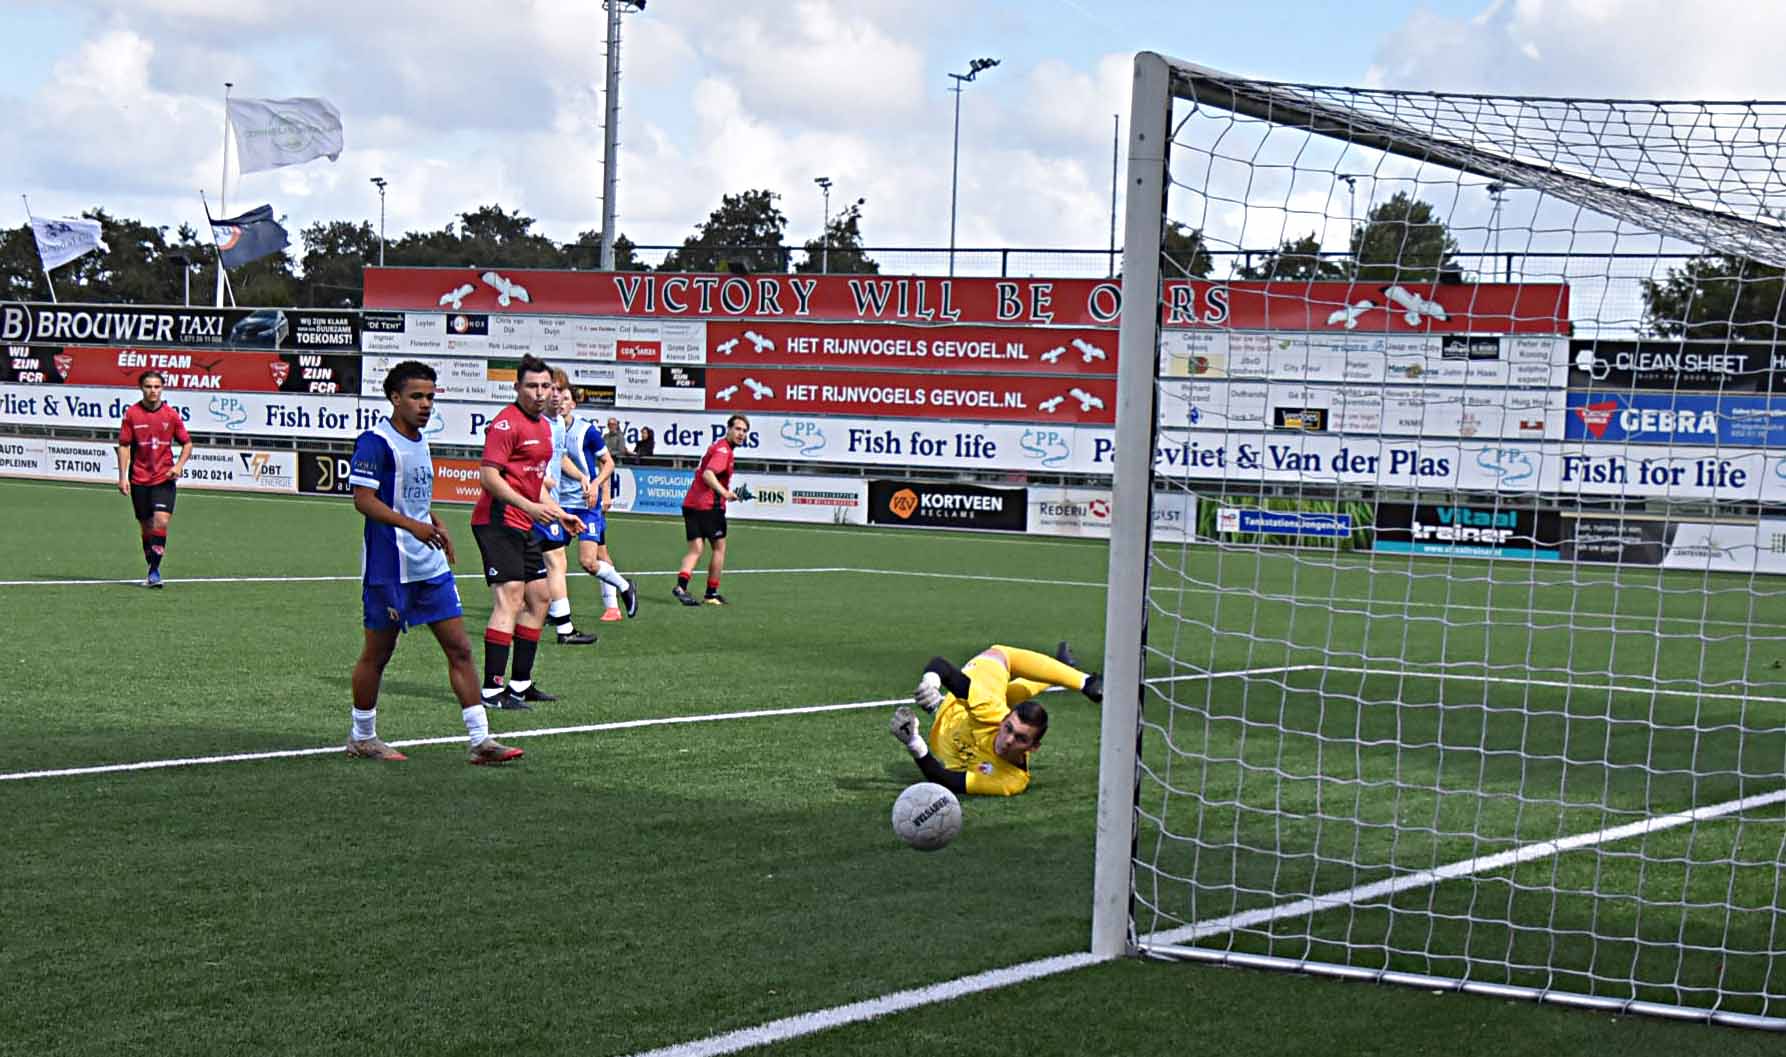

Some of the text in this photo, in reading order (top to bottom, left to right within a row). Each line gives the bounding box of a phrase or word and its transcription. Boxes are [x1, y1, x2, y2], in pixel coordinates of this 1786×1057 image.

[614, 276, 1230, 325] VICTORY WILL BE ORS
[2, 308, 23, 339] B
[37, 311, 174, 341] BROUWER
[179, 315, 224, 336] TAXI
[296, 333, 352, 345] TOEKOMST!
[787, 337, 1029, 360] HET RIJNVOGELS GEVOEL.NL
[9, 345, 29, 358] WIJ
[118, 353, 192, 369] ÉÉN TEAM
[300, 355, 322, 367] WIJ
[13, 358, 39, 370] ZIJN
[1616, 352, 1749, 373] CLEAN SHEET
[19, 371, 44, 383] FCR
[181, 374, 222, 388] TAAK
[304, 368, 332, 380] ZIJN
[309, 381, 337, 394] FCR
[786, 384, 1027, 409] HET RIJNVOGELS GEVOEL.NL
[43, 395, 60, 416] &
[65, 395, 103, 418] Van
[265, 404, 381, 430] Fish for lif
[1620, 408, 1718, 433] GEBRA
[664, 423, 703, 446] der
[848, 429, 996, 459] Fish for life
[55, 460, 101, 472] STATION
[1237, 444, 1260, 469] &
[1268, 445, 1322, 472] Van
[1332, 448, 1379, 474] der
[1389, 450, 1450, 477] Plas
[191, 469, 208, 480] 902
[210, 470, 233, 481] 0214
[261, 465, 281, 476] DBT
[438, 466, 481, 481] Hoogen
[1562, 456, 1747, 489] Fish for life
[456, 487, 481, 496] www
[759, 490, 785, 504] BOS
[921, 493, 1003, 512] KORTVEEN
[920, 509, 975, 519] RECLAME
[1437, 506, 1517, 528] Vitaal
[1411, 521, 1514, 543] trainer
